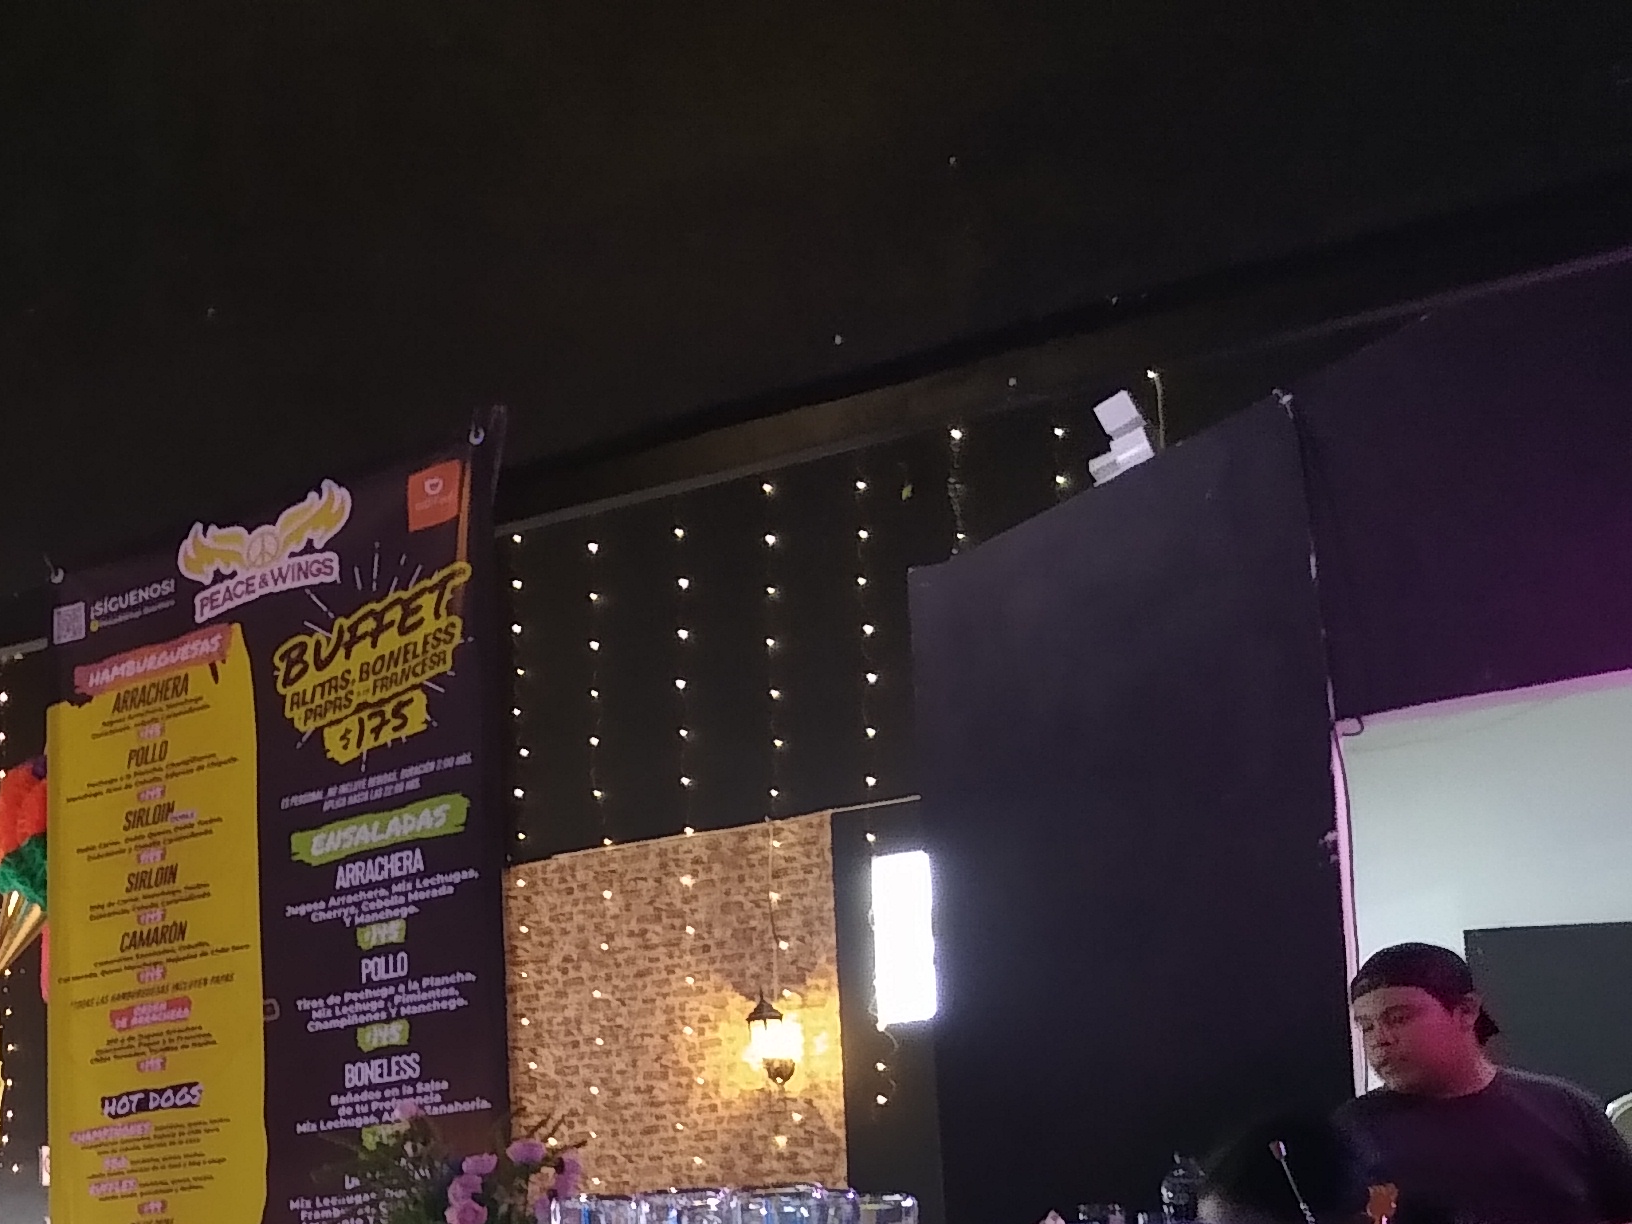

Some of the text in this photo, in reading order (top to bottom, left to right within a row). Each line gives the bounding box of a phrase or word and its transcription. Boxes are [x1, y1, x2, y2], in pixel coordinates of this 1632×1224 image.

[198, 575, 255, 617] PEACE
[258, 571, 270, 588] &
[270, 557, 334, 588] WINGS
[278, 567, 466, 689] BUFFET
[87, 633, 223, 688] HAMBURGUESAS
[359, 622, 456, 683] BONELESS
[112, 673, 189, 714] ARRACHERA
[304, 650, 447, 726] PAPAS FRANCESA
[339, 697, 414, 750] $175
[127, 740, 168, 769] POLLO
[123, 800, 175, 832] SIRLOIN
[311, 804, 451, 856] ENSALADAS
[125, 863, 178, 893] SIRLOIN
[335, 848, 425, 890] ARRACHERA
[361, 896, 407, 912] Cebolla
[408, 885, 455, 902] Morada
[361, 951, 409, 984] POLLO
[326, 994, 341, 1005] de
[344, 985, 396, 1003] Pechuga
[344, 1053, 421, 1088] BONELESS
[103, 1083, 204, 1116] HOT DOGS
[338, 1102, 369, 1117] de tu
[384, 1086, 400, 1098] en
